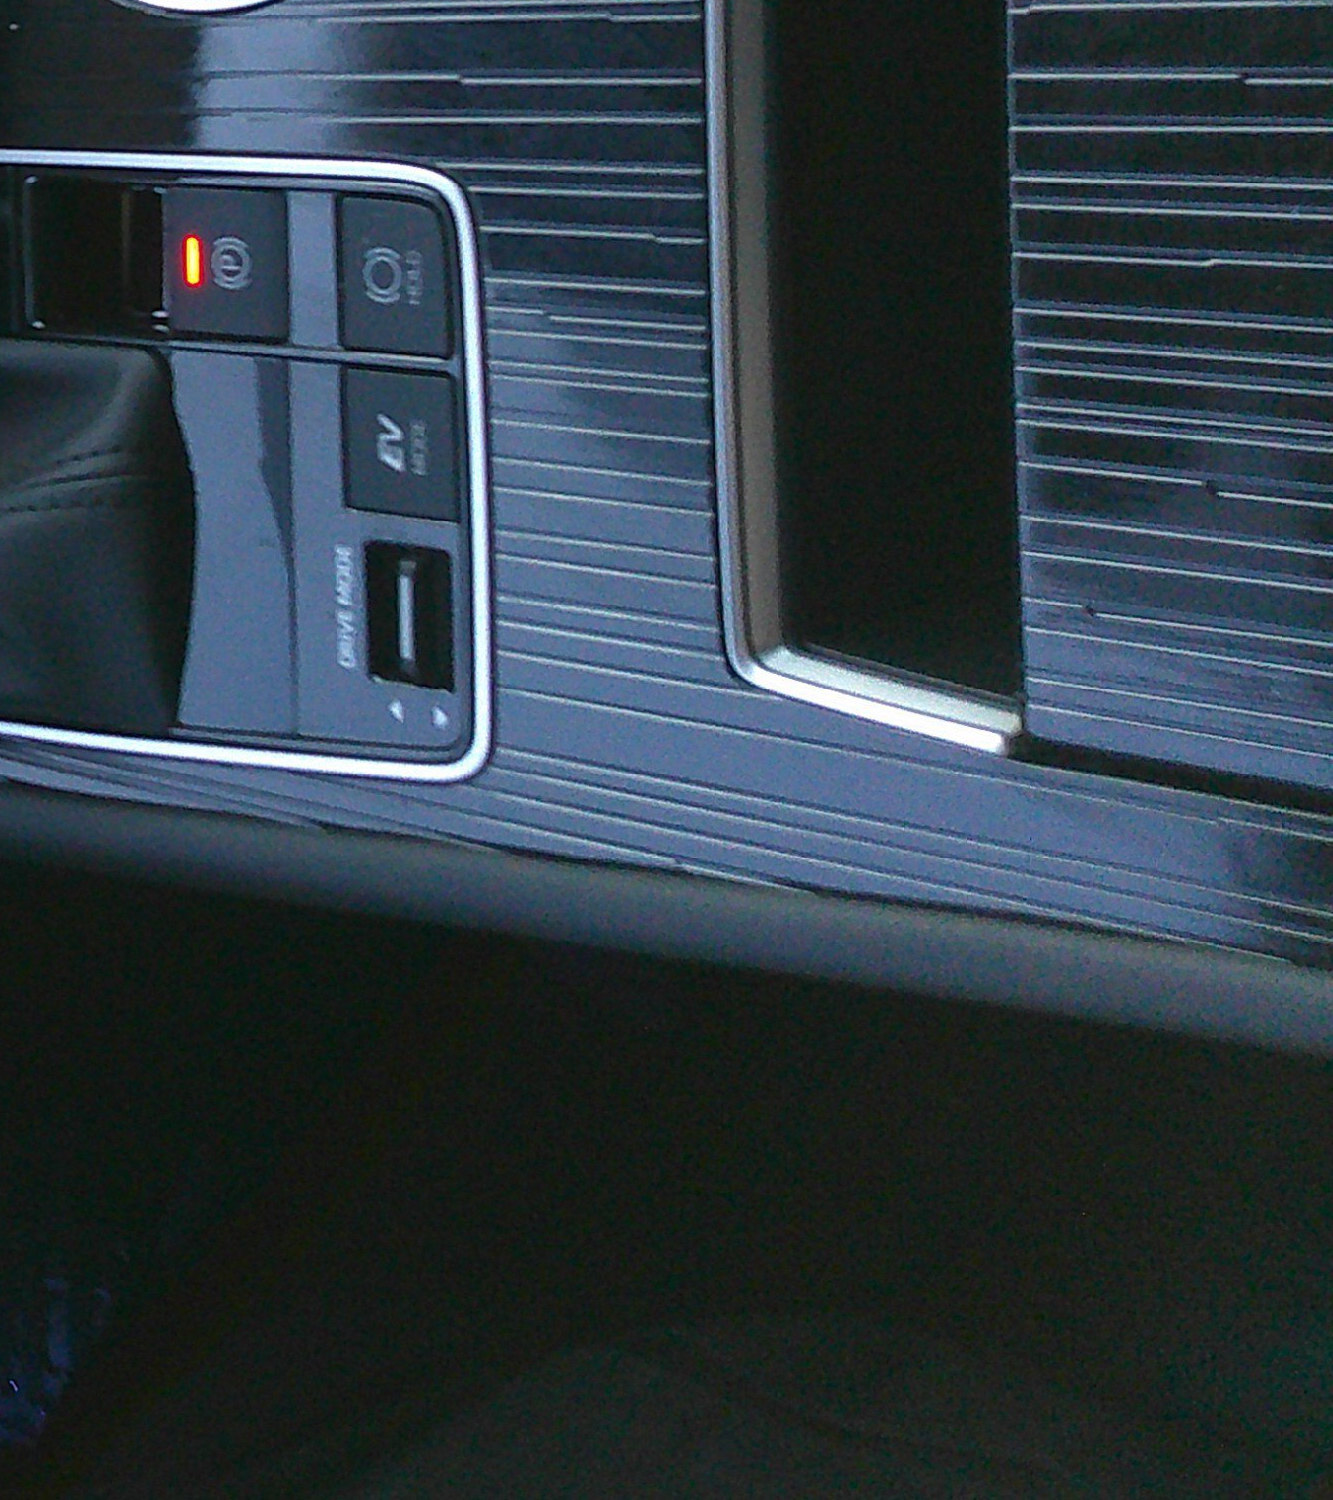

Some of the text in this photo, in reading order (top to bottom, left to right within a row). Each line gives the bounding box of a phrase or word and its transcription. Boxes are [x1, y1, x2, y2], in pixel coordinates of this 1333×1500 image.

[376, 412, 406, 473] EV
[334, 543, 358, 669] DRIVE MODE
